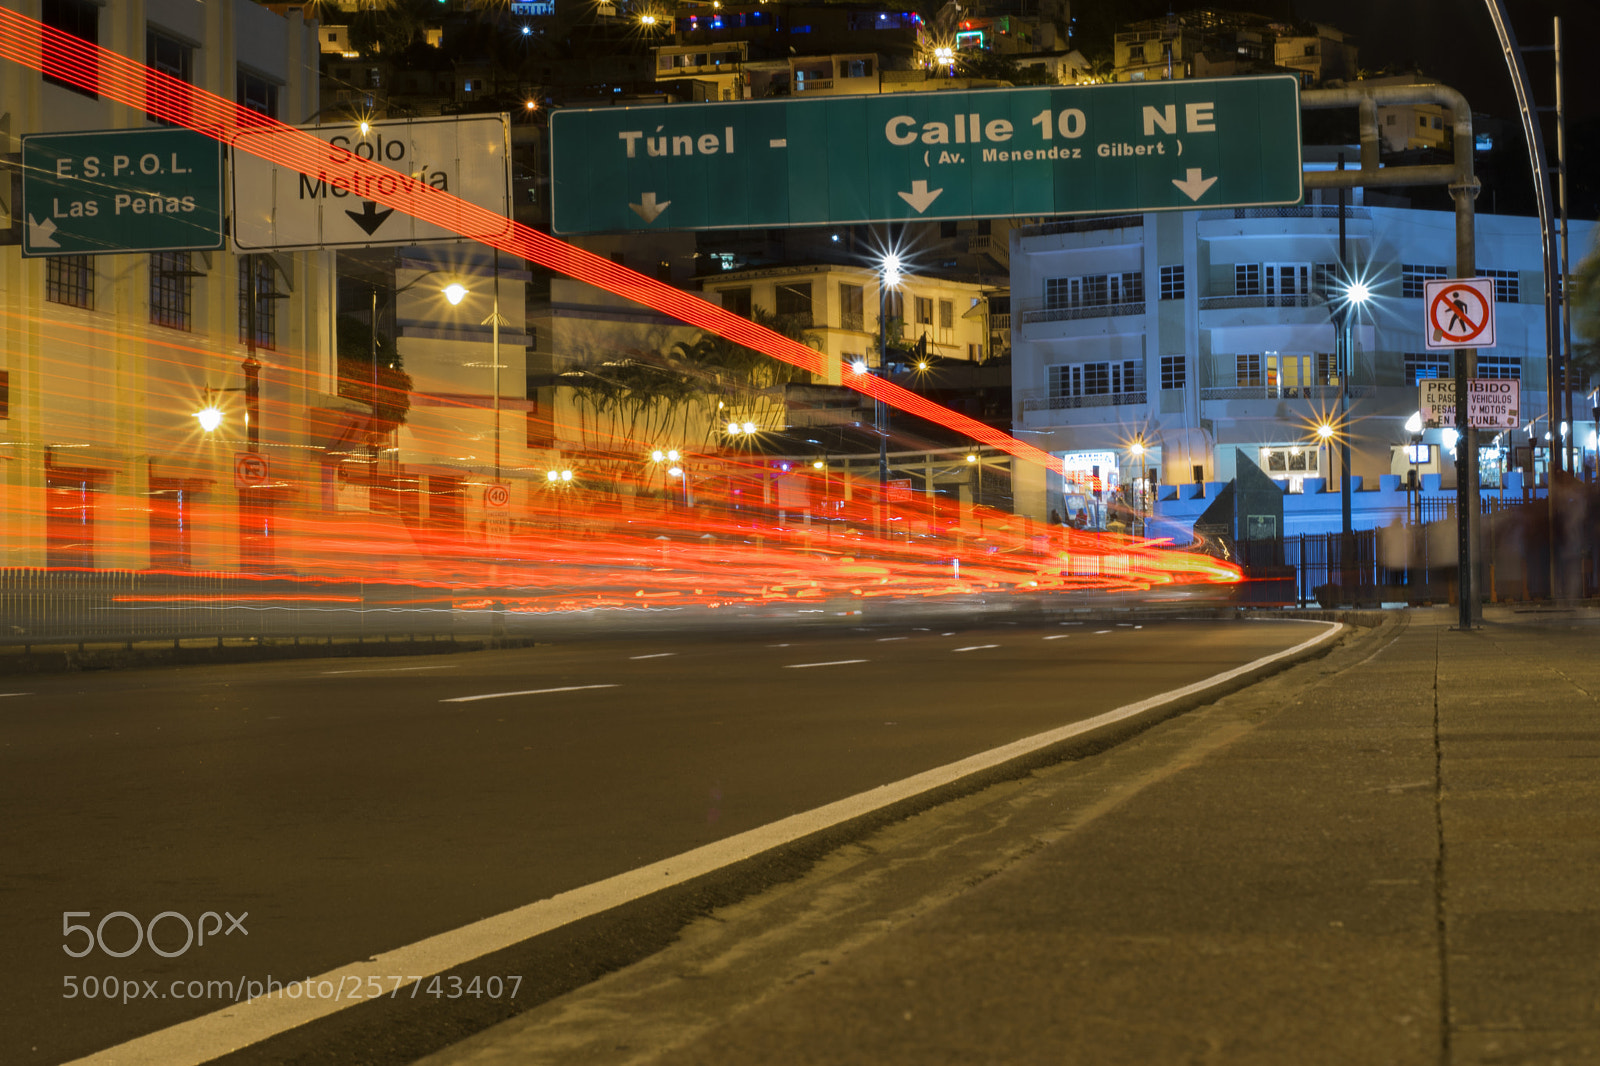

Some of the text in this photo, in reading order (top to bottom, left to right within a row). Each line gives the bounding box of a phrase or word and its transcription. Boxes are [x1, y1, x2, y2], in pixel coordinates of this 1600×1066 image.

[618, 125, 734, 158] Túnel
[885, 113, 1014, 146] Calle
[1031, 108, 1087, 140] 10
[1142, 102, 1216, 136] NE
[329, 134, 405, 164] Solo
[938, 151, 965, 165] Av.
[982, 147, 1082, 162] Menendez
[1097, 142, 1165, 158] Gilbert
[299, 165, 449, 200] Metrovía
[53, 191, 196, 219] Las Peñas
[1428, 383, 1511, 393] PROIBIDO
[1426, 394, 1436, 403] EL
[1471, 395, 1512, 404] VEHICULOS
[1471, 405, 1476, 414] Y
[1479, 405, 1507, 414] MOTOS
[1438, 416, 1450, 425] EN
[1470, 415, 1500, 425] TUNEL
[491, 490, 505, 502] 40
